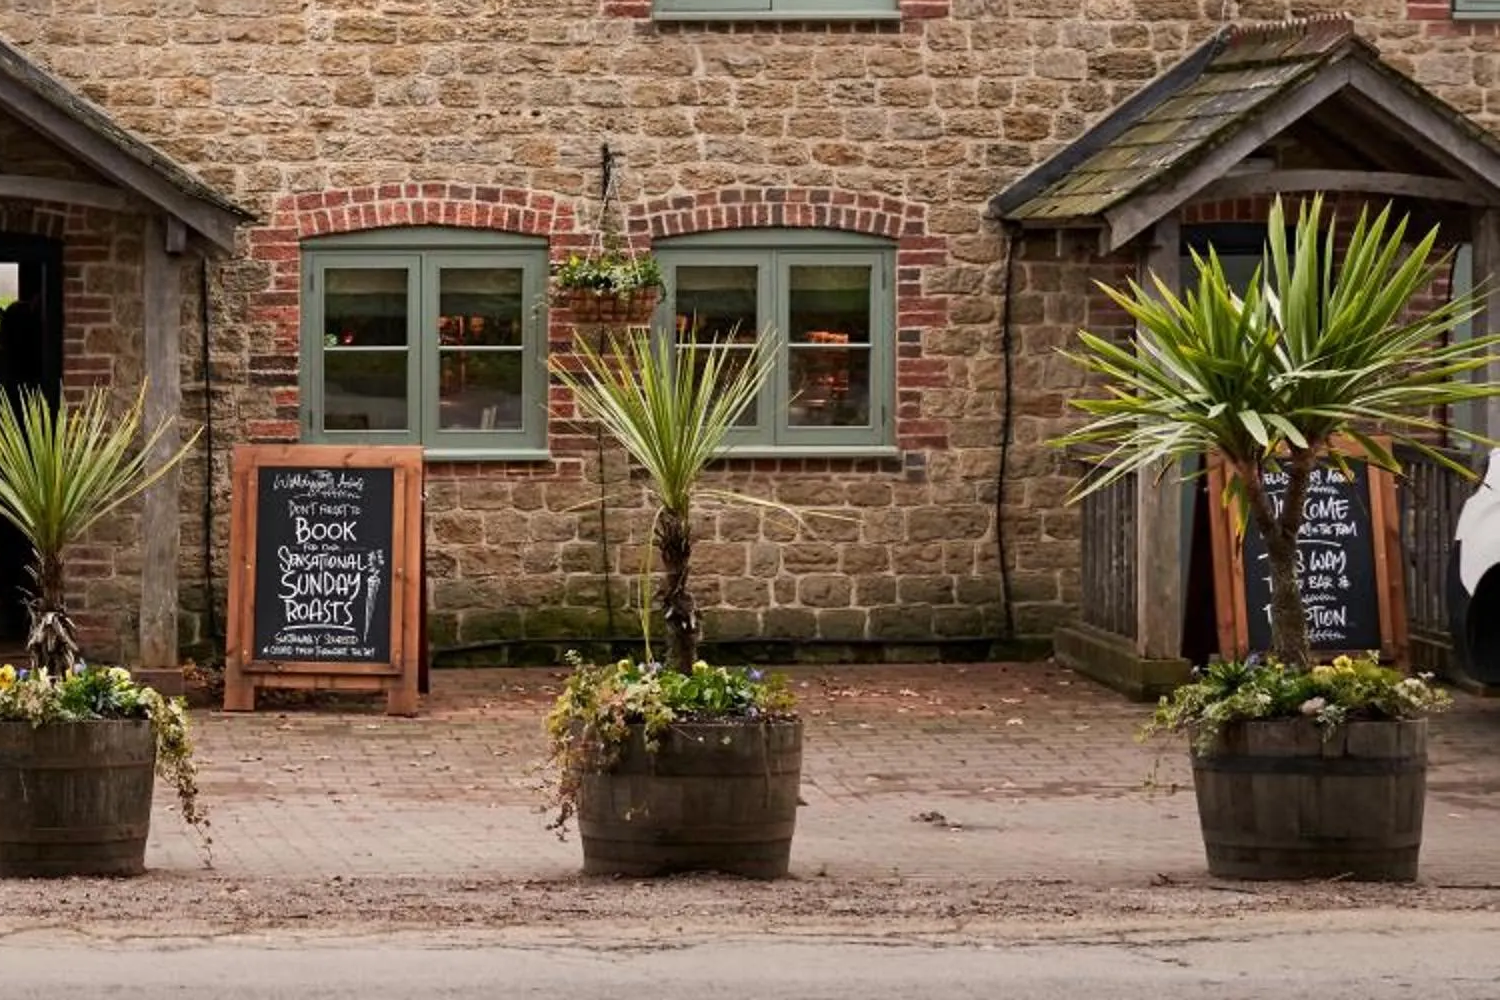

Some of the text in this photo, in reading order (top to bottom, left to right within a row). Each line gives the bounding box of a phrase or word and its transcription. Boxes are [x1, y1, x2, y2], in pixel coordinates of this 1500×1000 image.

[295, 516, 357, 545] BOOK
[277, 545, 367, 573] SENSATIONAL
[1309, 549, 1347, 574] WAY
[277, 570, 361, 601] SUNDAY
[283, 598, 354, 626] ROASTS
